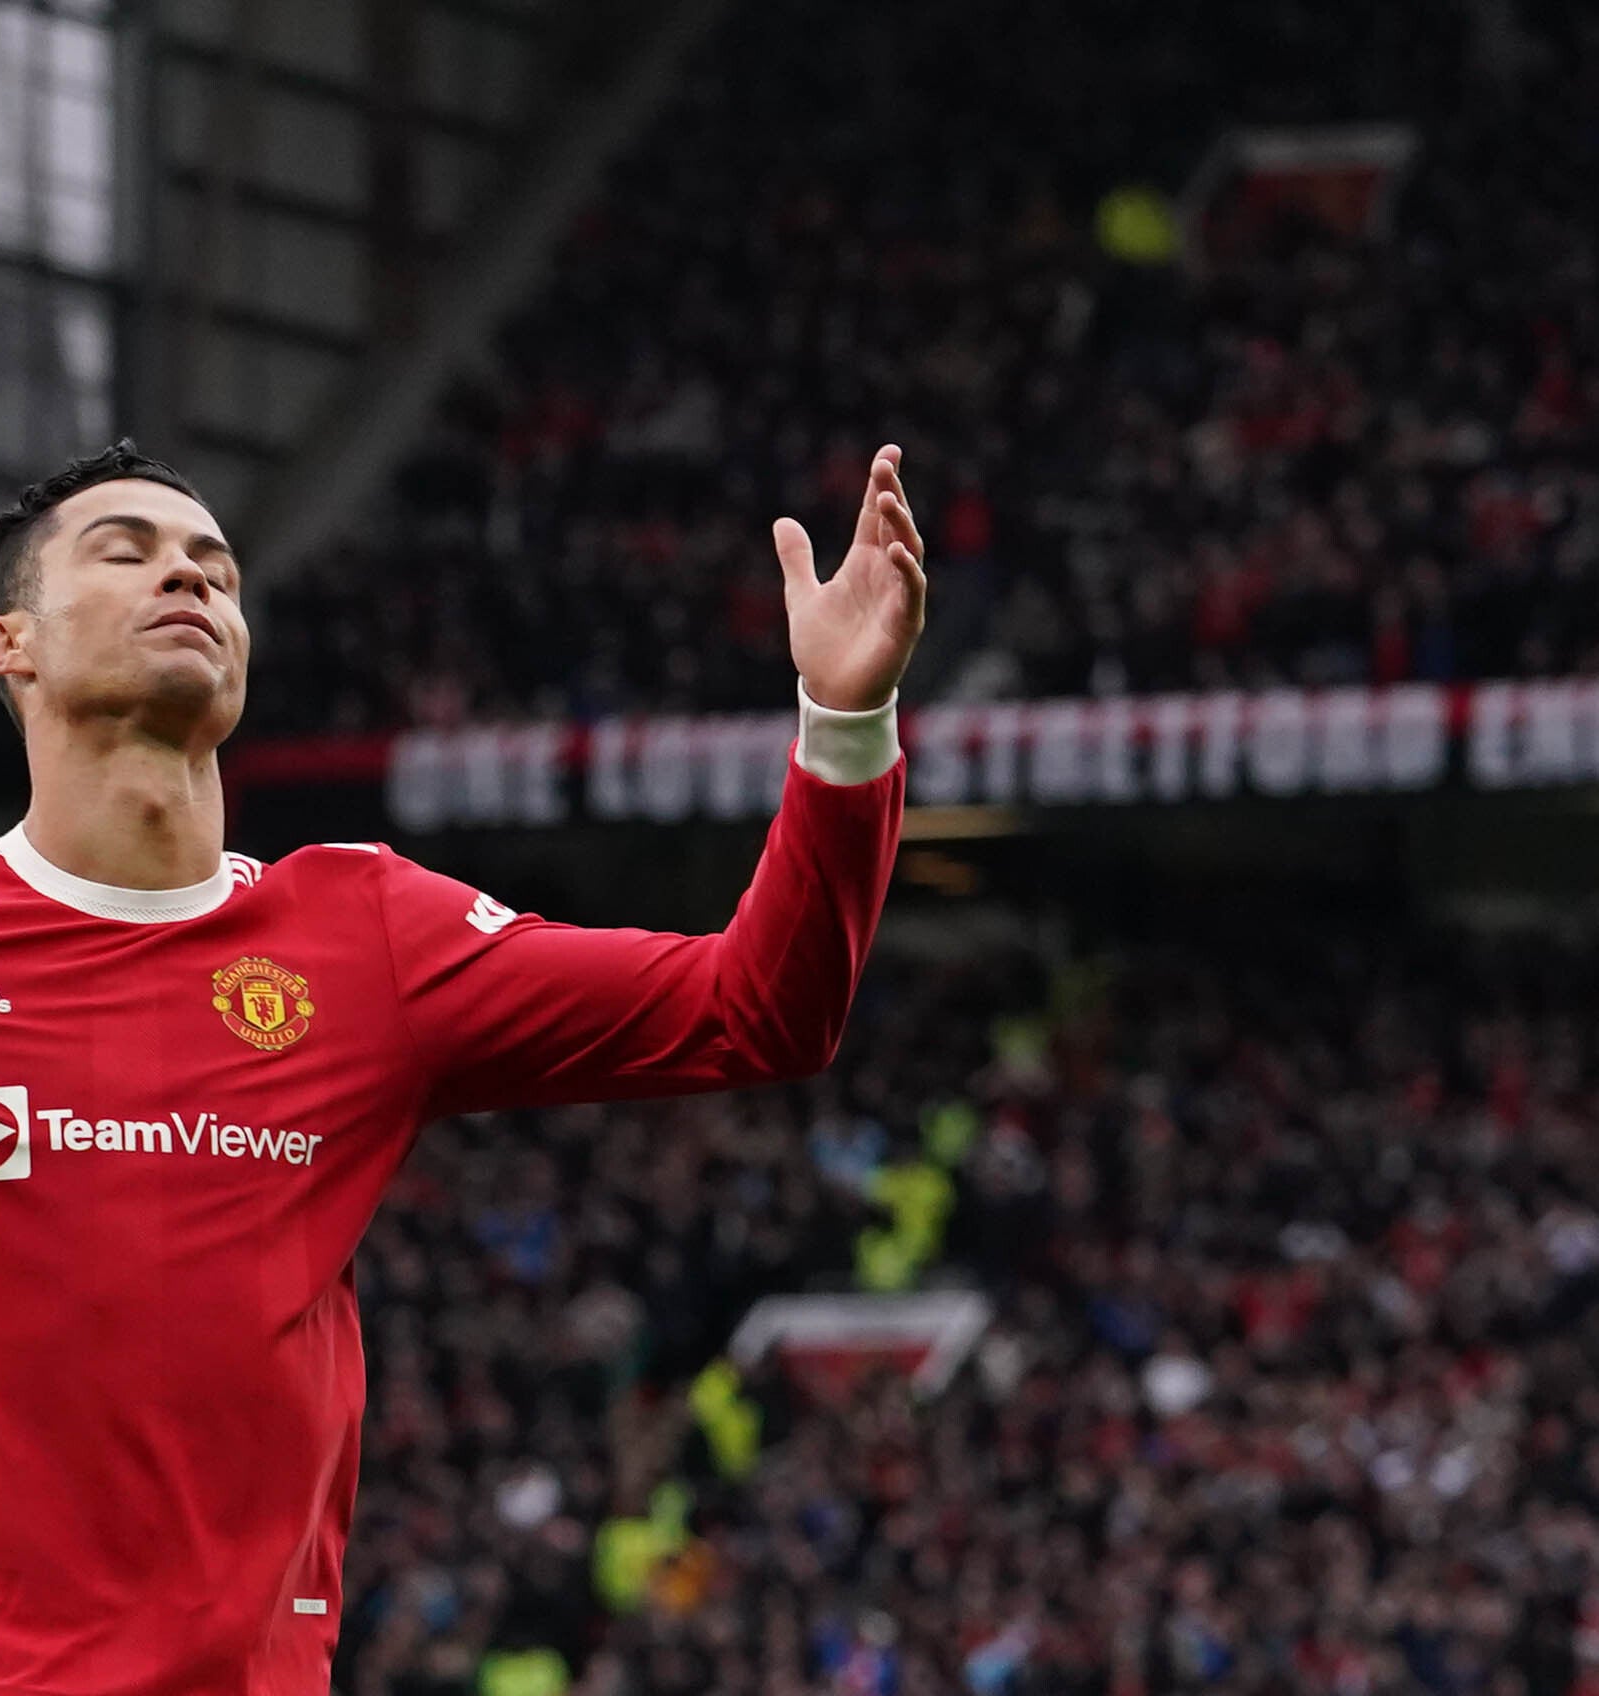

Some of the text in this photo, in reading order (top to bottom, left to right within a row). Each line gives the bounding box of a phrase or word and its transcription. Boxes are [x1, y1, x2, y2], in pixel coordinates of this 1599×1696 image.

[220, 963, 302, 1044] MANCHESTER UNITED
[36, 1108, 323, 1167] TeamViewer
